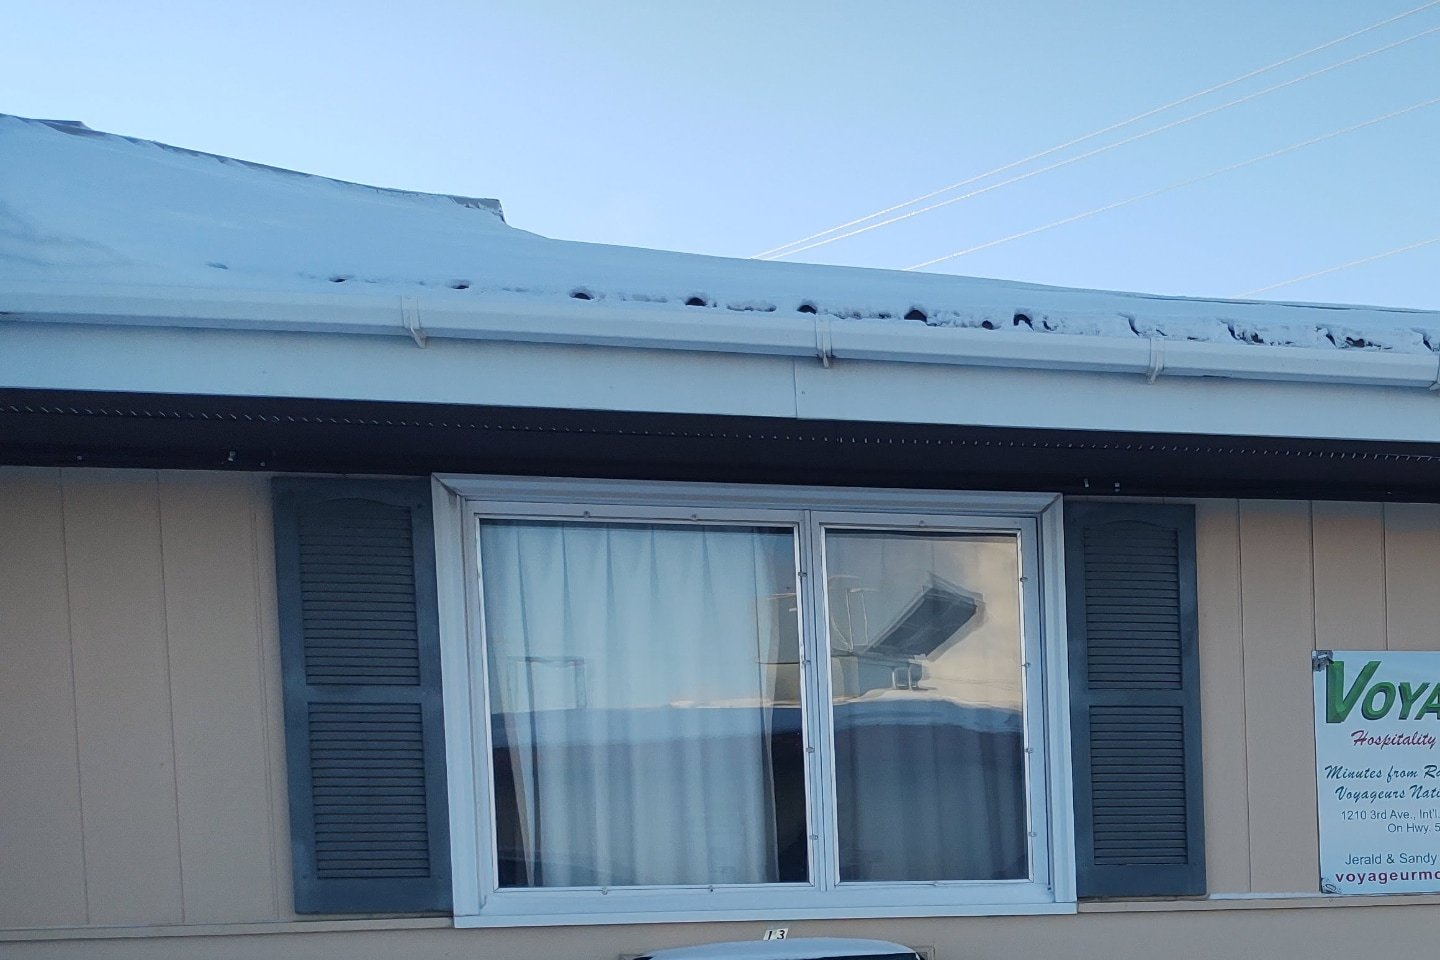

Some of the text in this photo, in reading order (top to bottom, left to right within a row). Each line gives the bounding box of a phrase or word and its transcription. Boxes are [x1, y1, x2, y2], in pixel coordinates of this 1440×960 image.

[1350, 729, 1437, 750] Hospitality
[1324, 765, 1382, 780] Minutes
[1386, 765, 1419, 783] from
[1335, 785, 1406, 804] Voyageurs
[1341, 811, 1367, 821] 1210
[1369, 810, 1387, 820] 3rd
[1387, 823, 1403, 833] On
[1406, 823, 1431, 835] Hwy.
[1345, 853, 1382, 865] Jerald
[1386, 853, 1395, 864] &
[1399, 852, 1438, 866] Sandy
[767, 930, 786, 941] 13
